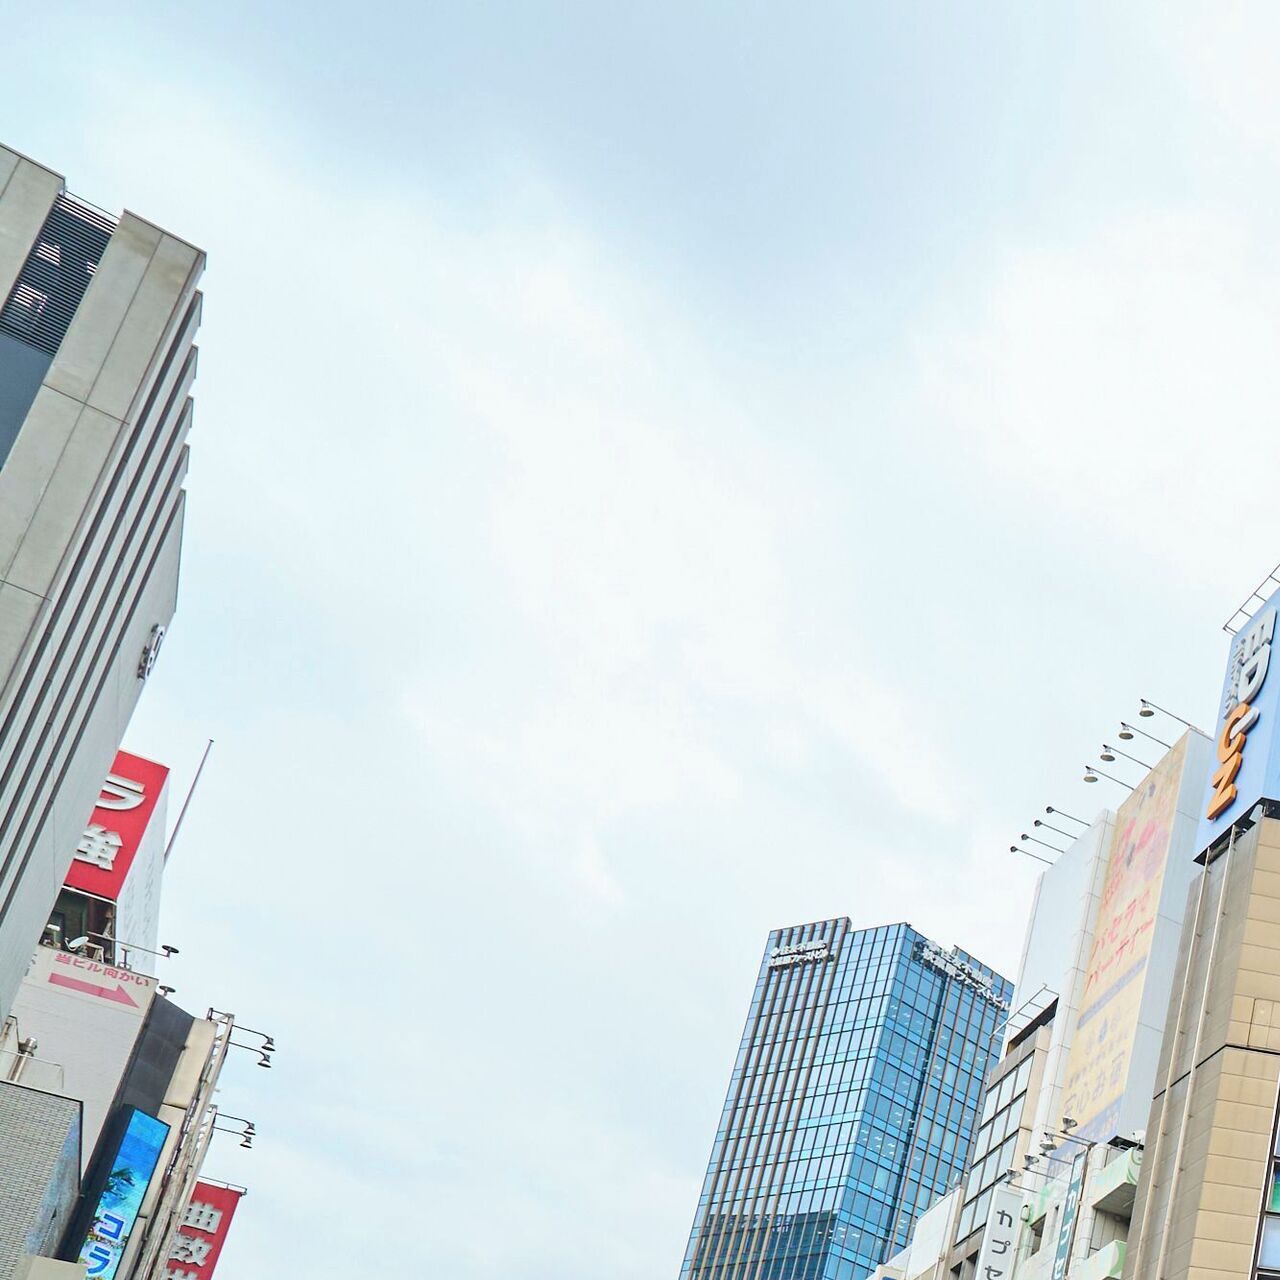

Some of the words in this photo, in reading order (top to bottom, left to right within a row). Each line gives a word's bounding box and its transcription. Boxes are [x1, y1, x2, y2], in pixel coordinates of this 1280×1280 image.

[1207, 607, 1277, 820] EDION
[54, 952, 151, 988] 当ビル向かい
